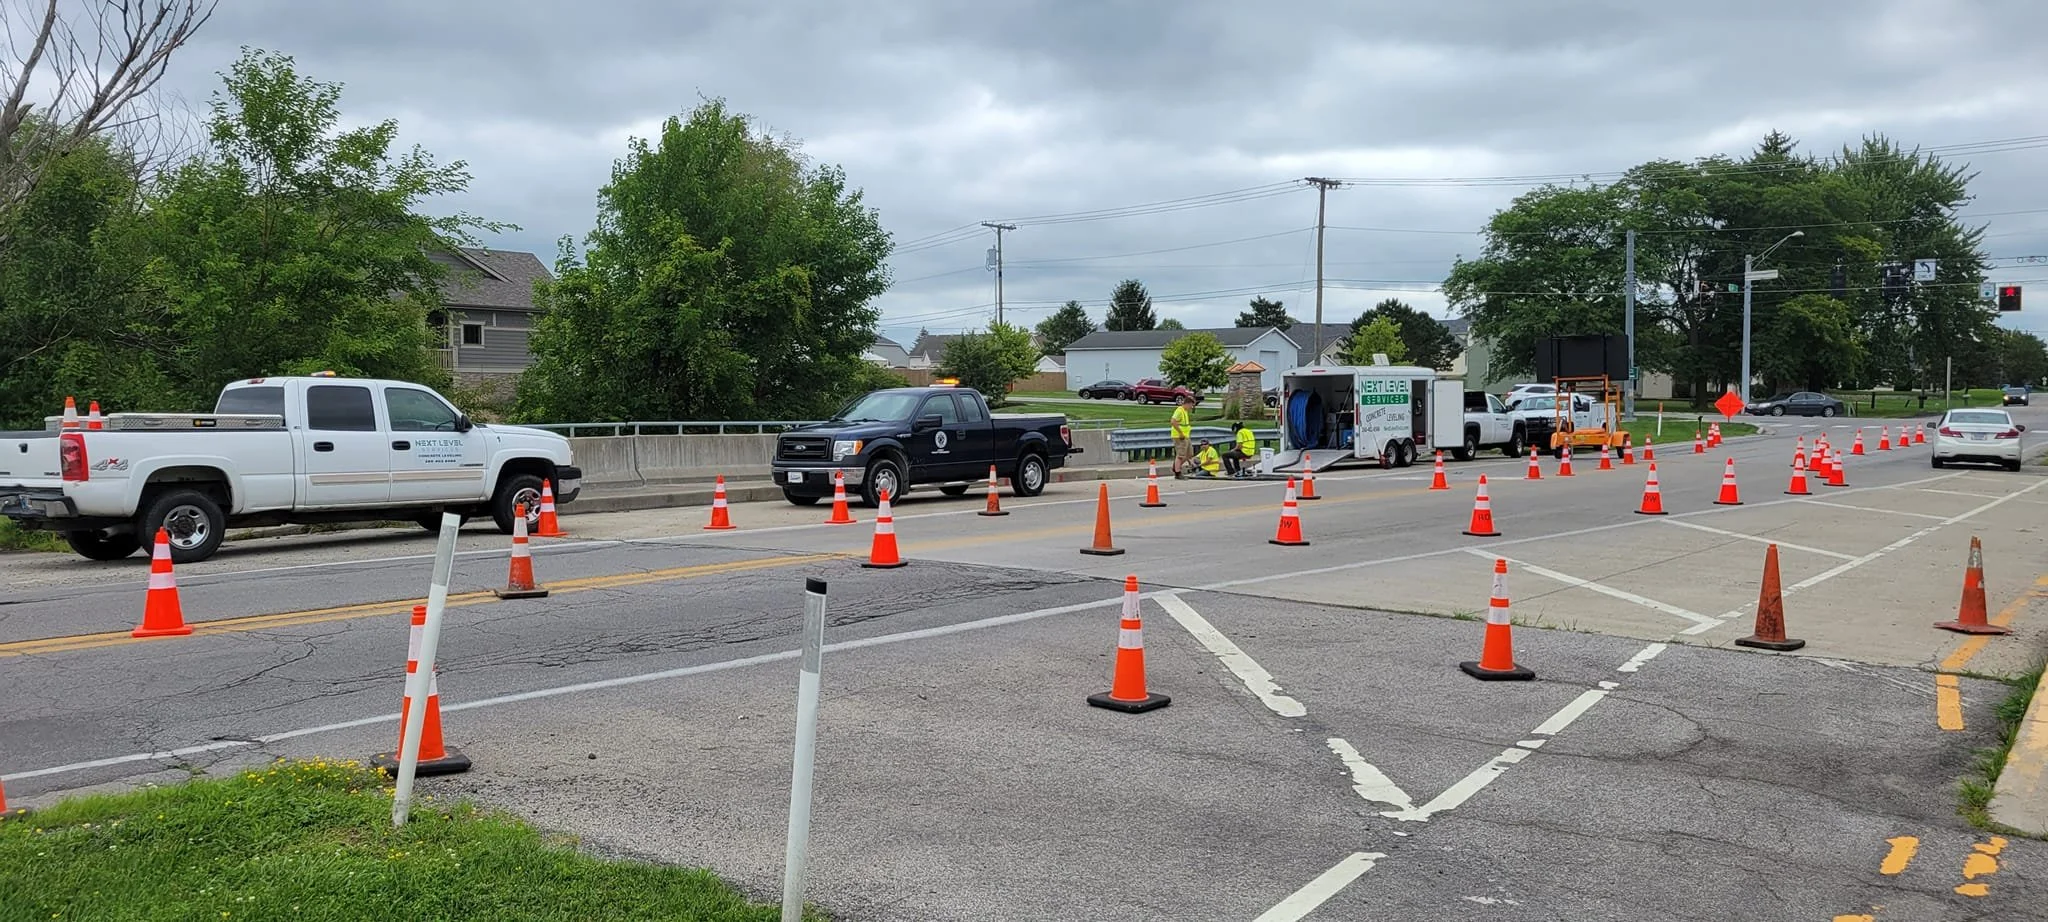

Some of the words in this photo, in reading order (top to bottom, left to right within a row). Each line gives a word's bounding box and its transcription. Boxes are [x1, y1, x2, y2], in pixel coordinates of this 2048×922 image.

[1361, 380, 1383, 392] NEXT
[1385, 380, 1408, 392] LEVEL
[1366, 394, 1405, 404] SERVICES
